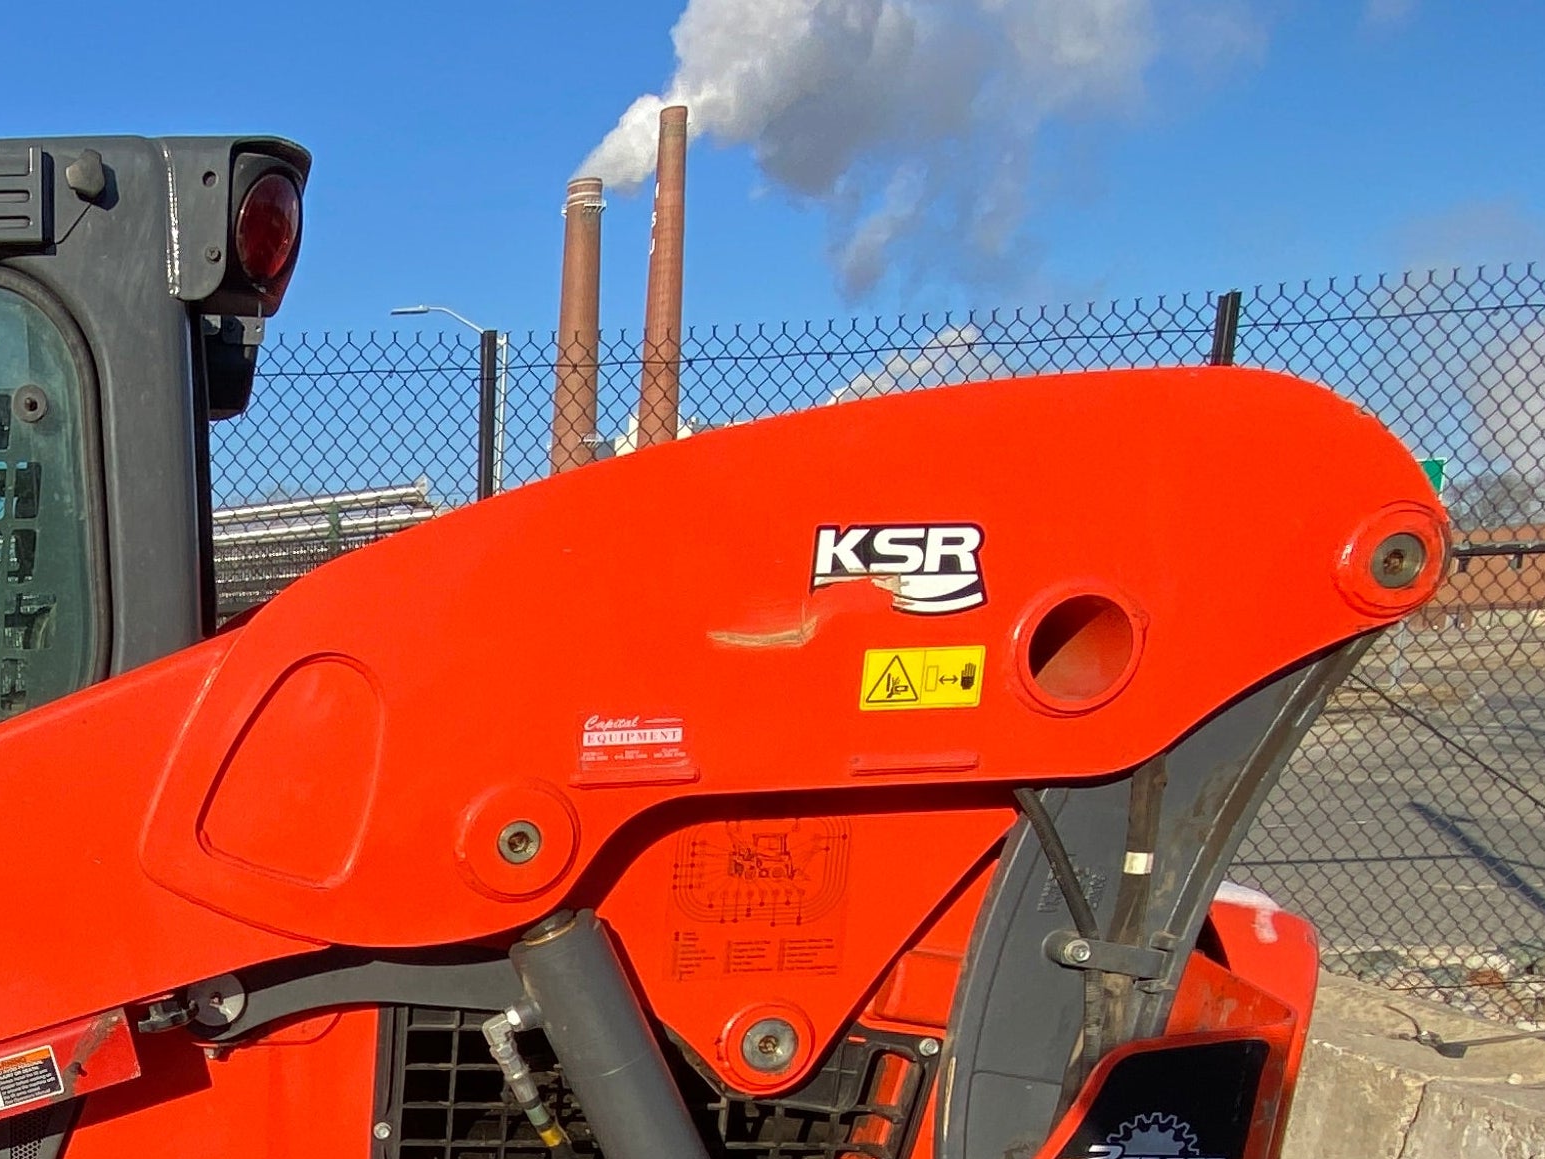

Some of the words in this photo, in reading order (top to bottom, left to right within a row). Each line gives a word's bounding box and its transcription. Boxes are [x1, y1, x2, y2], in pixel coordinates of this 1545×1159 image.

[815, 526, 981, 574] KSR
[584, 714, 640, 731] Capital
[586, 729, 680, 745] EQUIPMENT
